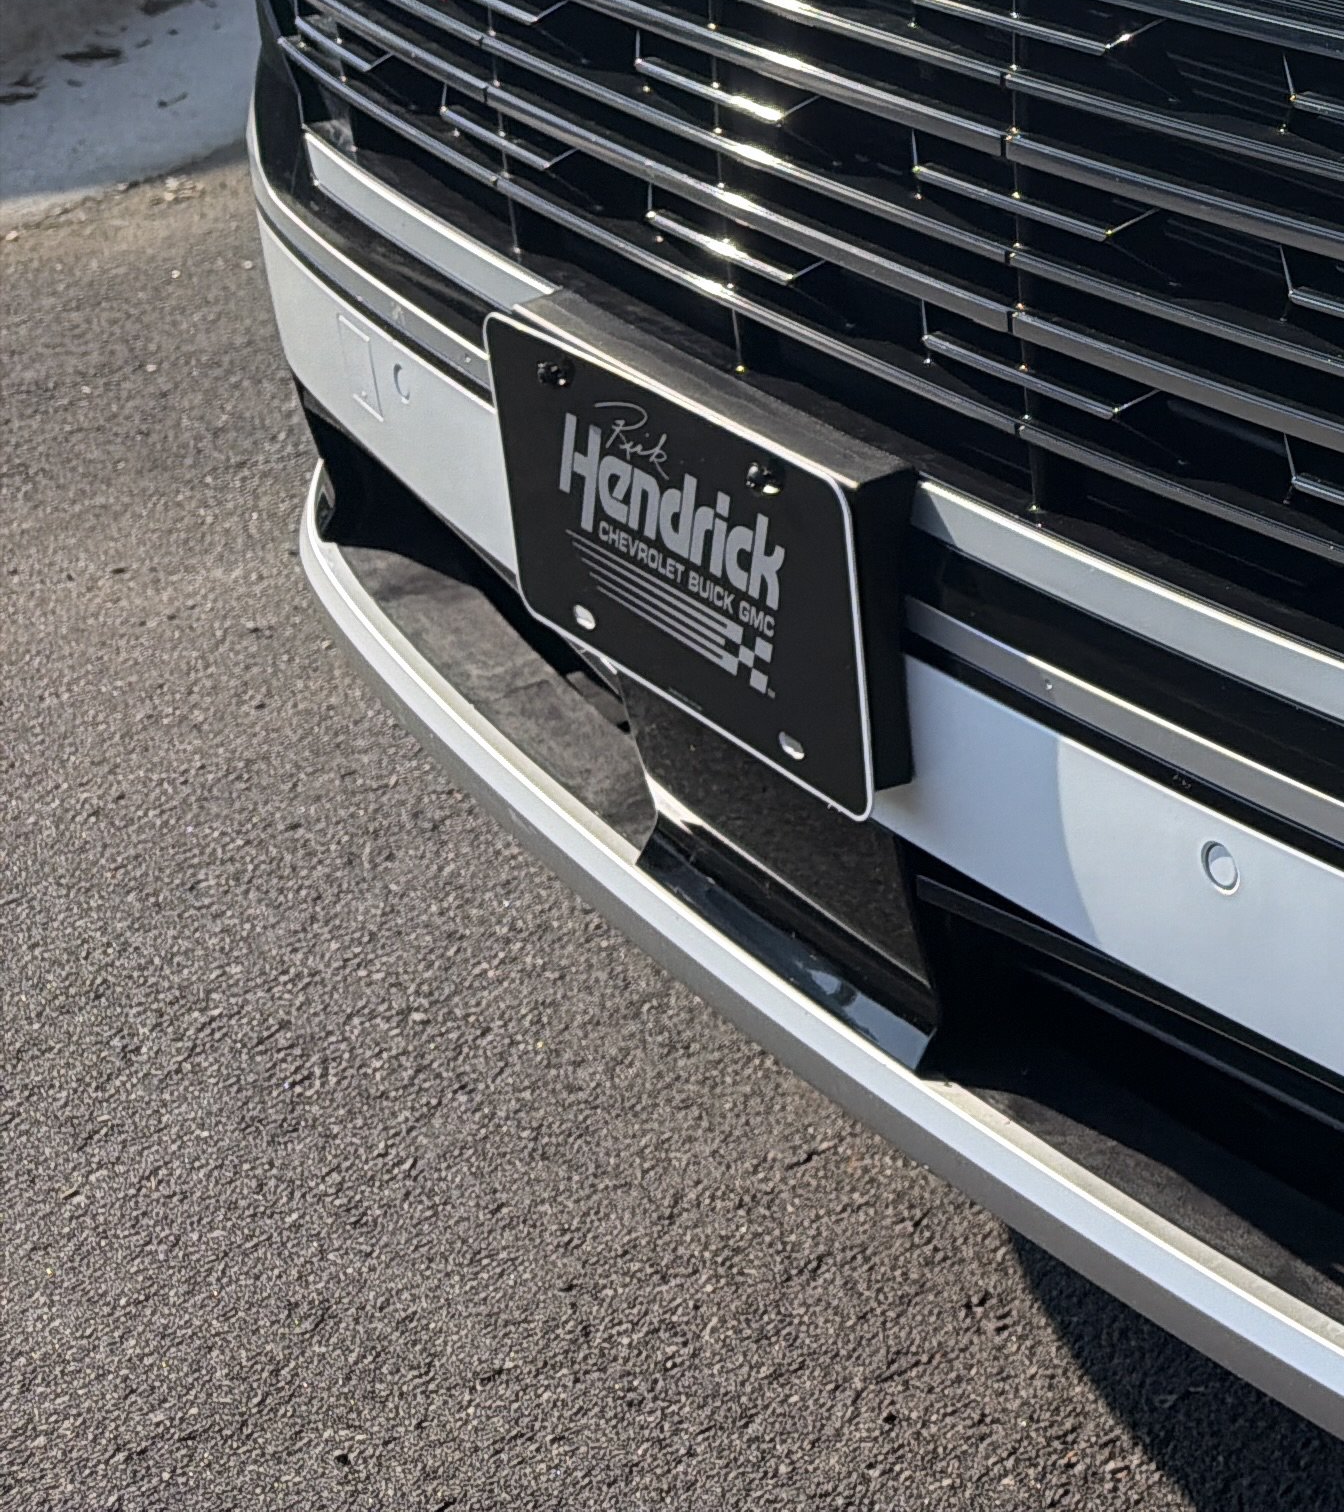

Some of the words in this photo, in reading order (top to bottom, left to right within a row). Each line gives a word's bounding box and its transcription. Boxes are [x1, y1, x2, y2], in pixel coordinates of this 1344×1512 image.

[559, 412, 785, 610] Hendrick
[598, 519, 686, 586] CHEVROLET
[688, 570, 735, 617] BUICK
[738, 601, 776, 638] GMC
